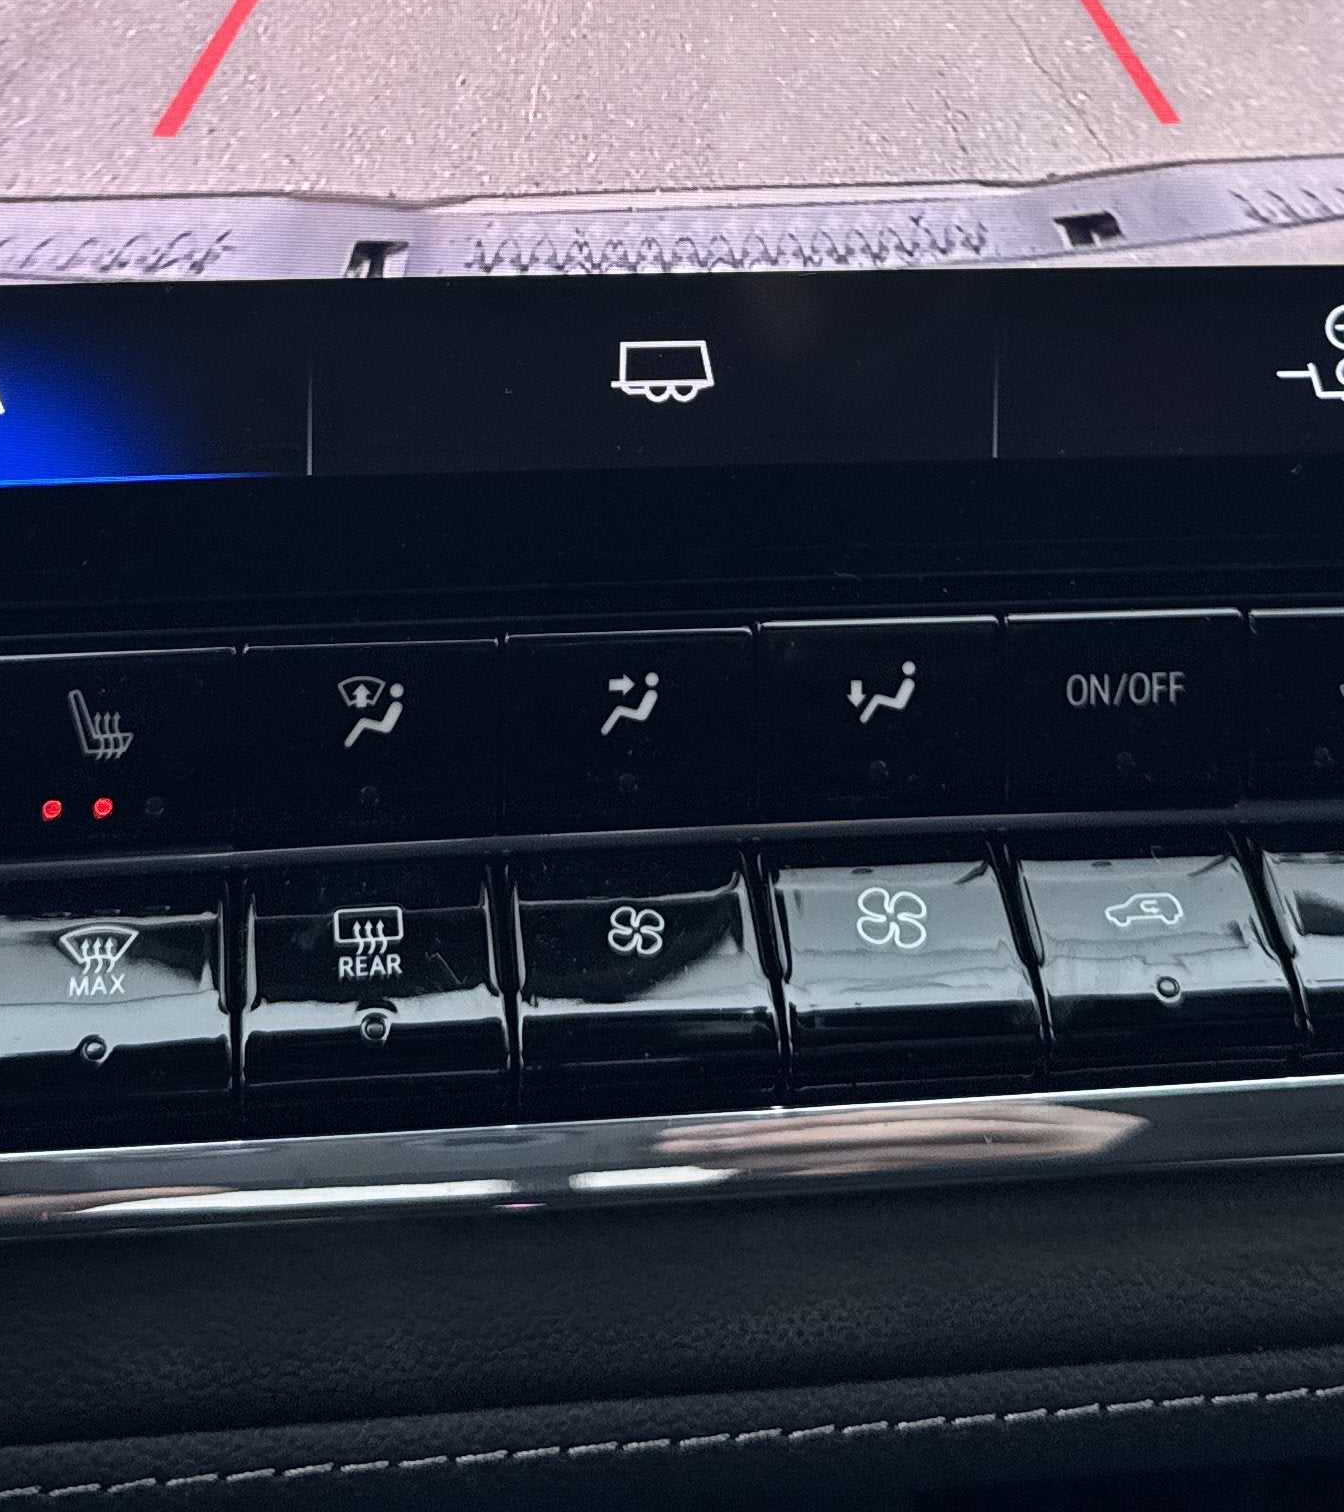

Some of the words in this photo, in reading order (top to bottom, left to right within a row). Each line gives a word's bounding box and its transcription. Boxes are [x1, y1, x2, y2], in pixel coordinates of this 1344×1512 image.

[1065, 670, 1186, 707] ON/OFF
[338, 953, 404, 979] REAR
[68, 973, 126, 997] MAX
